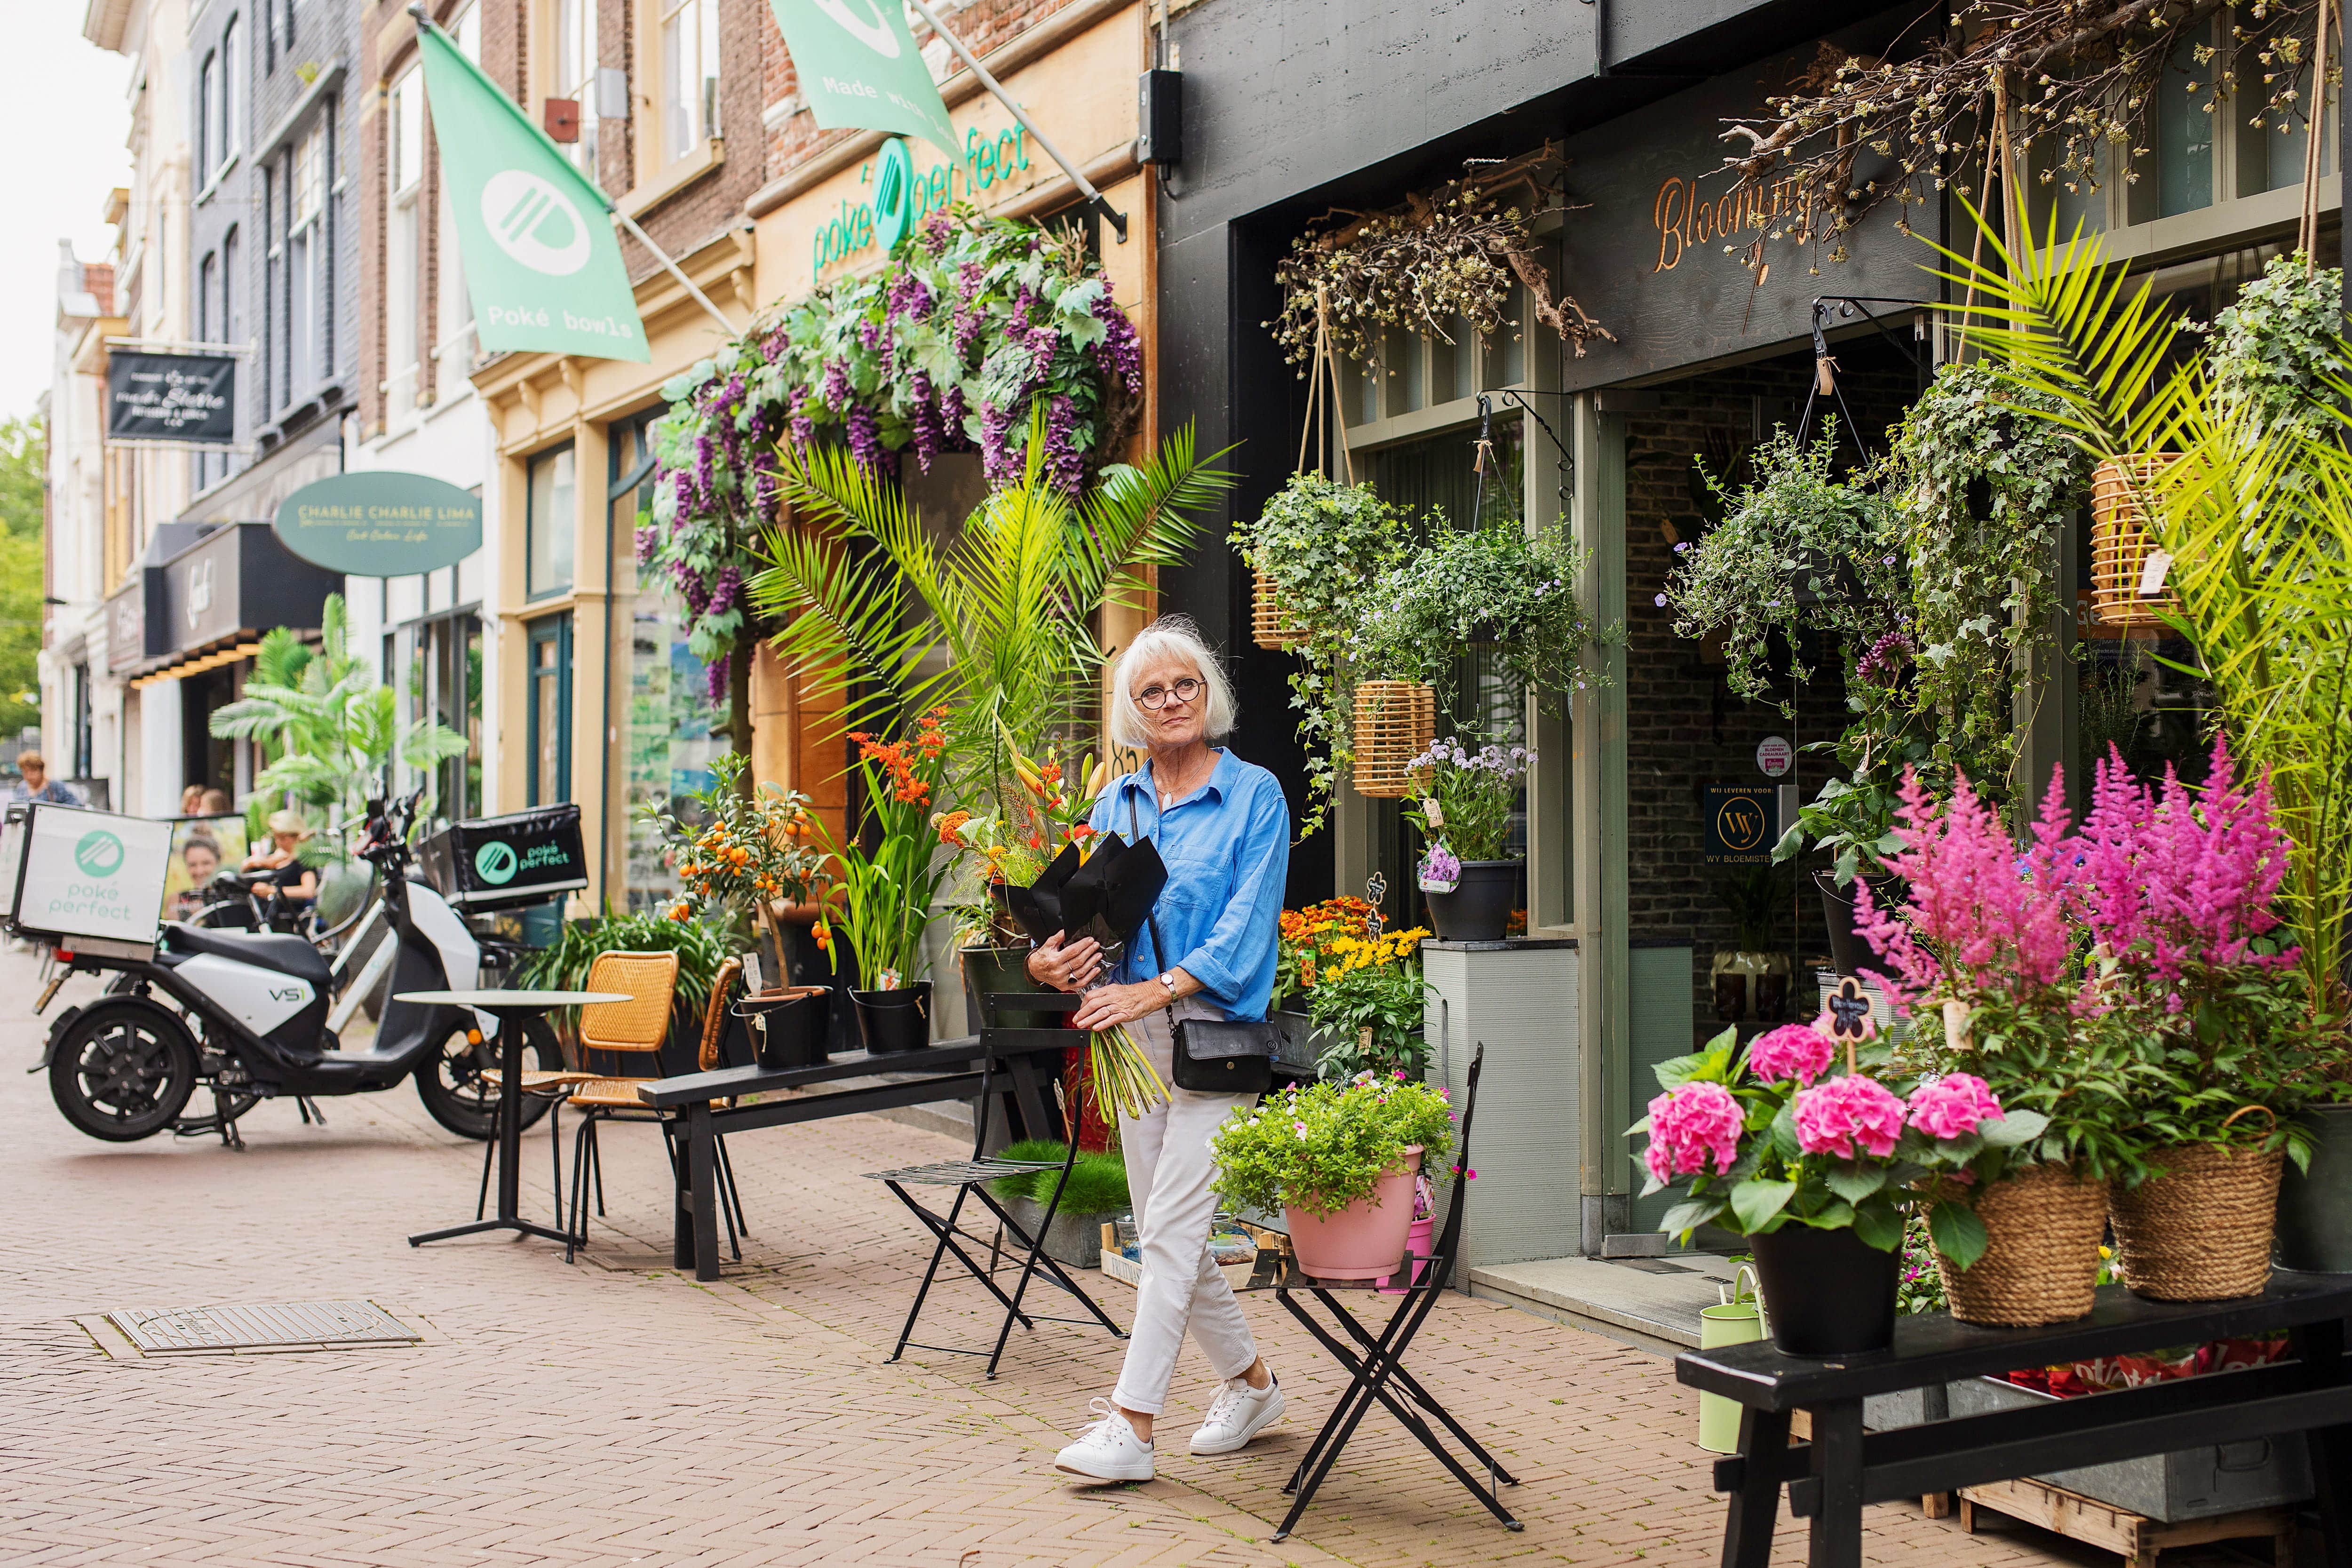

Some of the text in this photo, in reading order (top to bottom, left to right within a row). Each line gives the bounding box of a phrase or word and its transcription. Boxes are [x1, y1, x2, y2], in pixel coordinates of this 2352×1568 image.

[823, 76, 878, 98] Made
[910, 103, 1029, 236] perfect
[487, 305, 633, 339] Poké bowls
[298, 504, 475, 520] CHARLIE CHARLIE LIMA
[519, 851, 571, 872] perfect
[67, 880, 119, 900] poké
[48, 899, 131, 922] perfect
